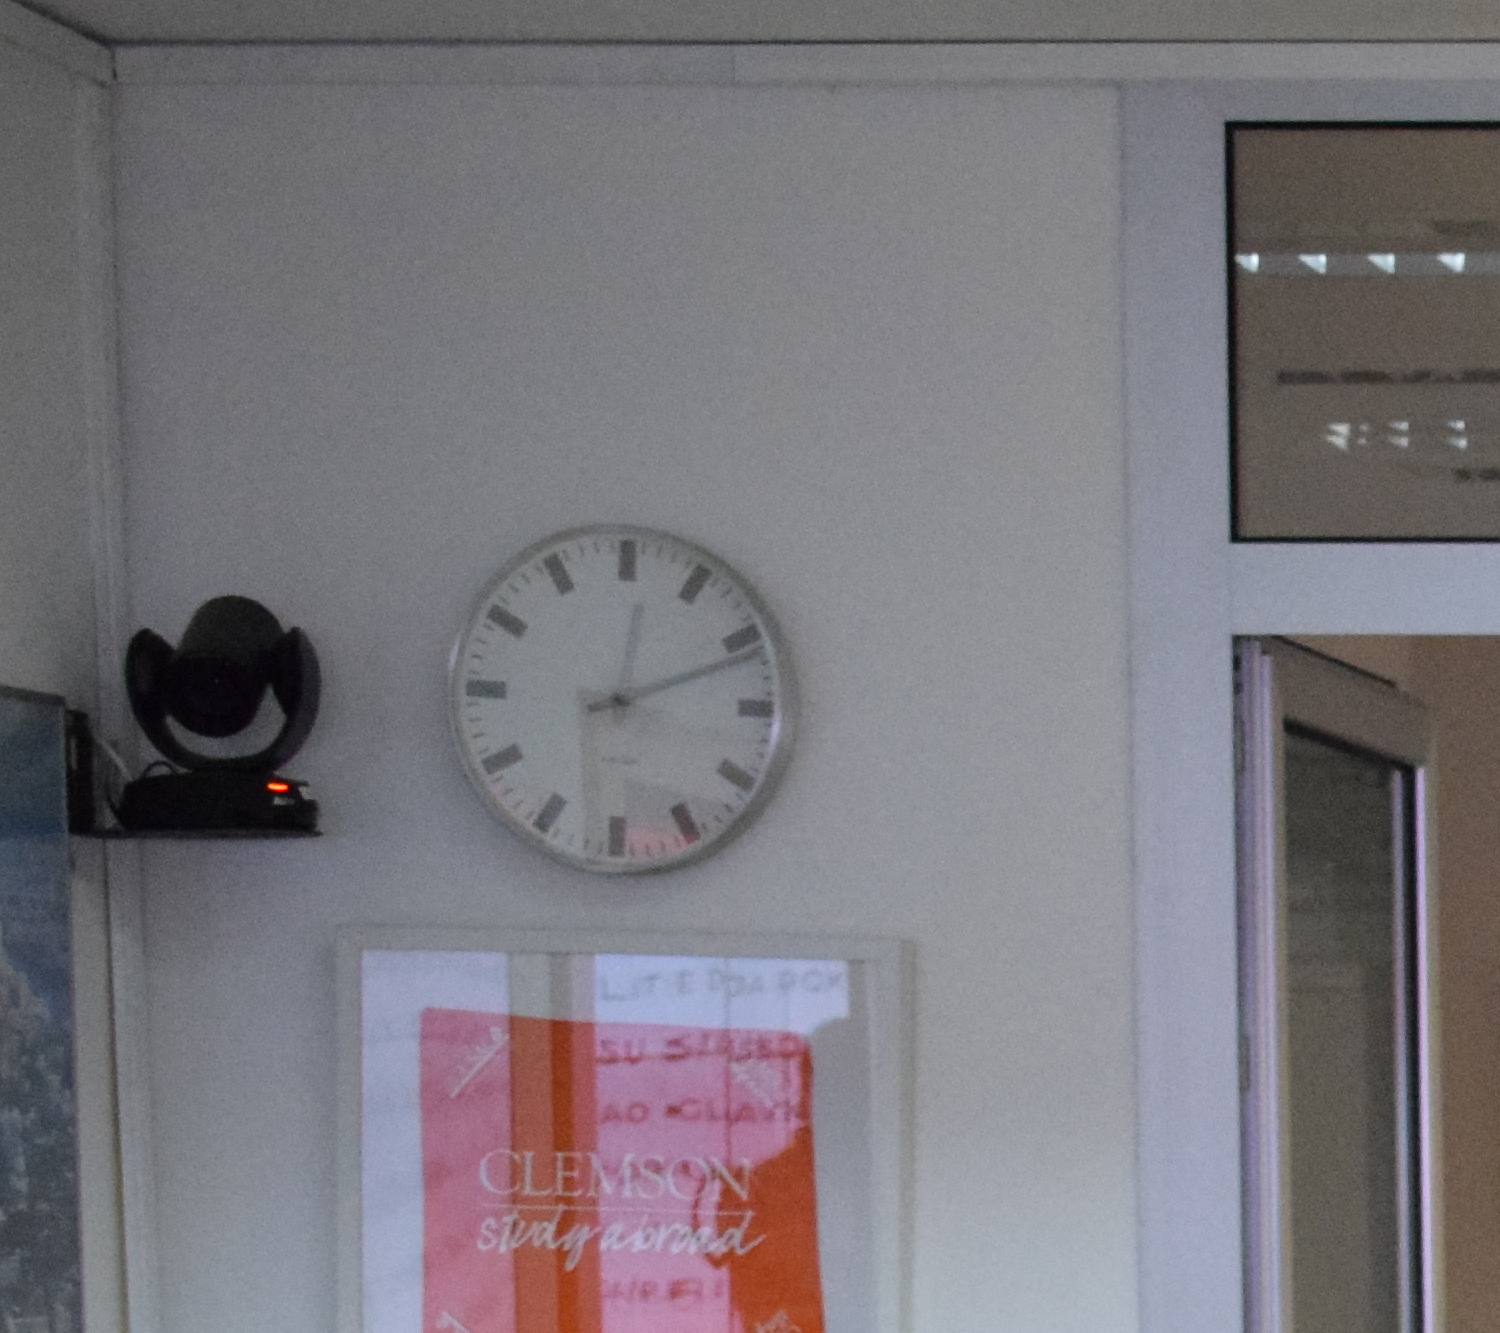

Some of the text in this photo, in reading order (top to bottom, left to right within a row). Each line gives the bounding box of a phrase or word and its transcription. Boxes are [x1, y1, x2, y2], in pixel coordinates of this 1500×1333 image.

[479, 1148, 755, 1203] CLEMSON
[477, 1211, 765, 1273] study abroad
